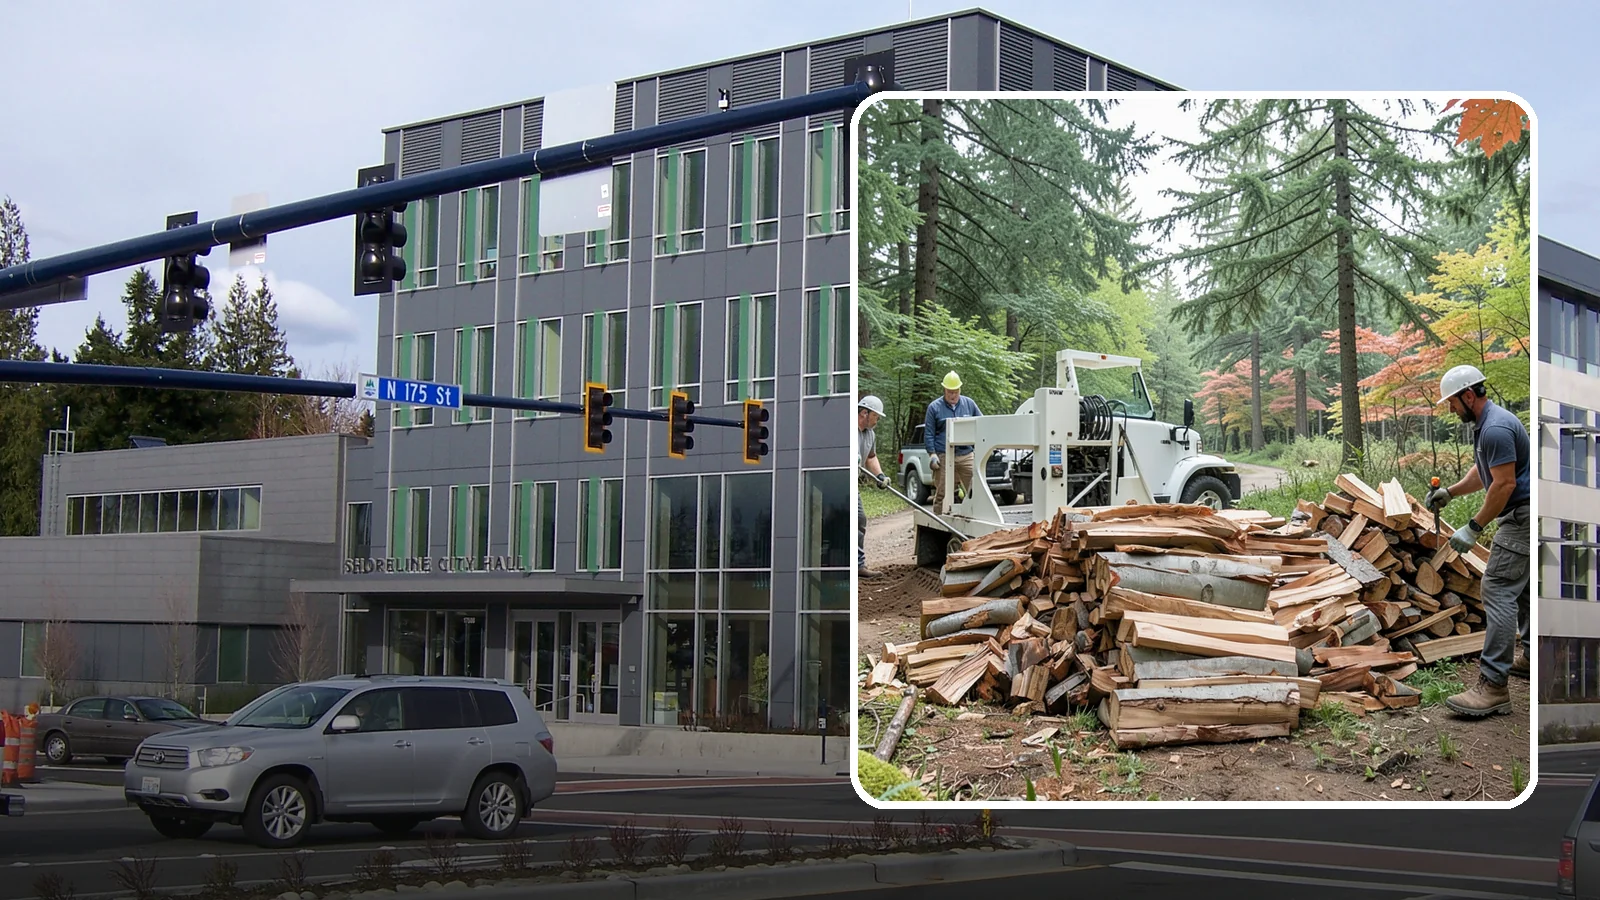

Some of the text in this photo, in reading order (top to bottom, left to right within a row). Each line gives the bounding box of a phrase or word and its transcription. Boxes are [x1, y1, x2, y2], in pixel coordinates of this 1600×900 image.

[387, 380, 451, 406] N 175 St
[344, 556, 526, 574] SHORELINE CITY HALL
